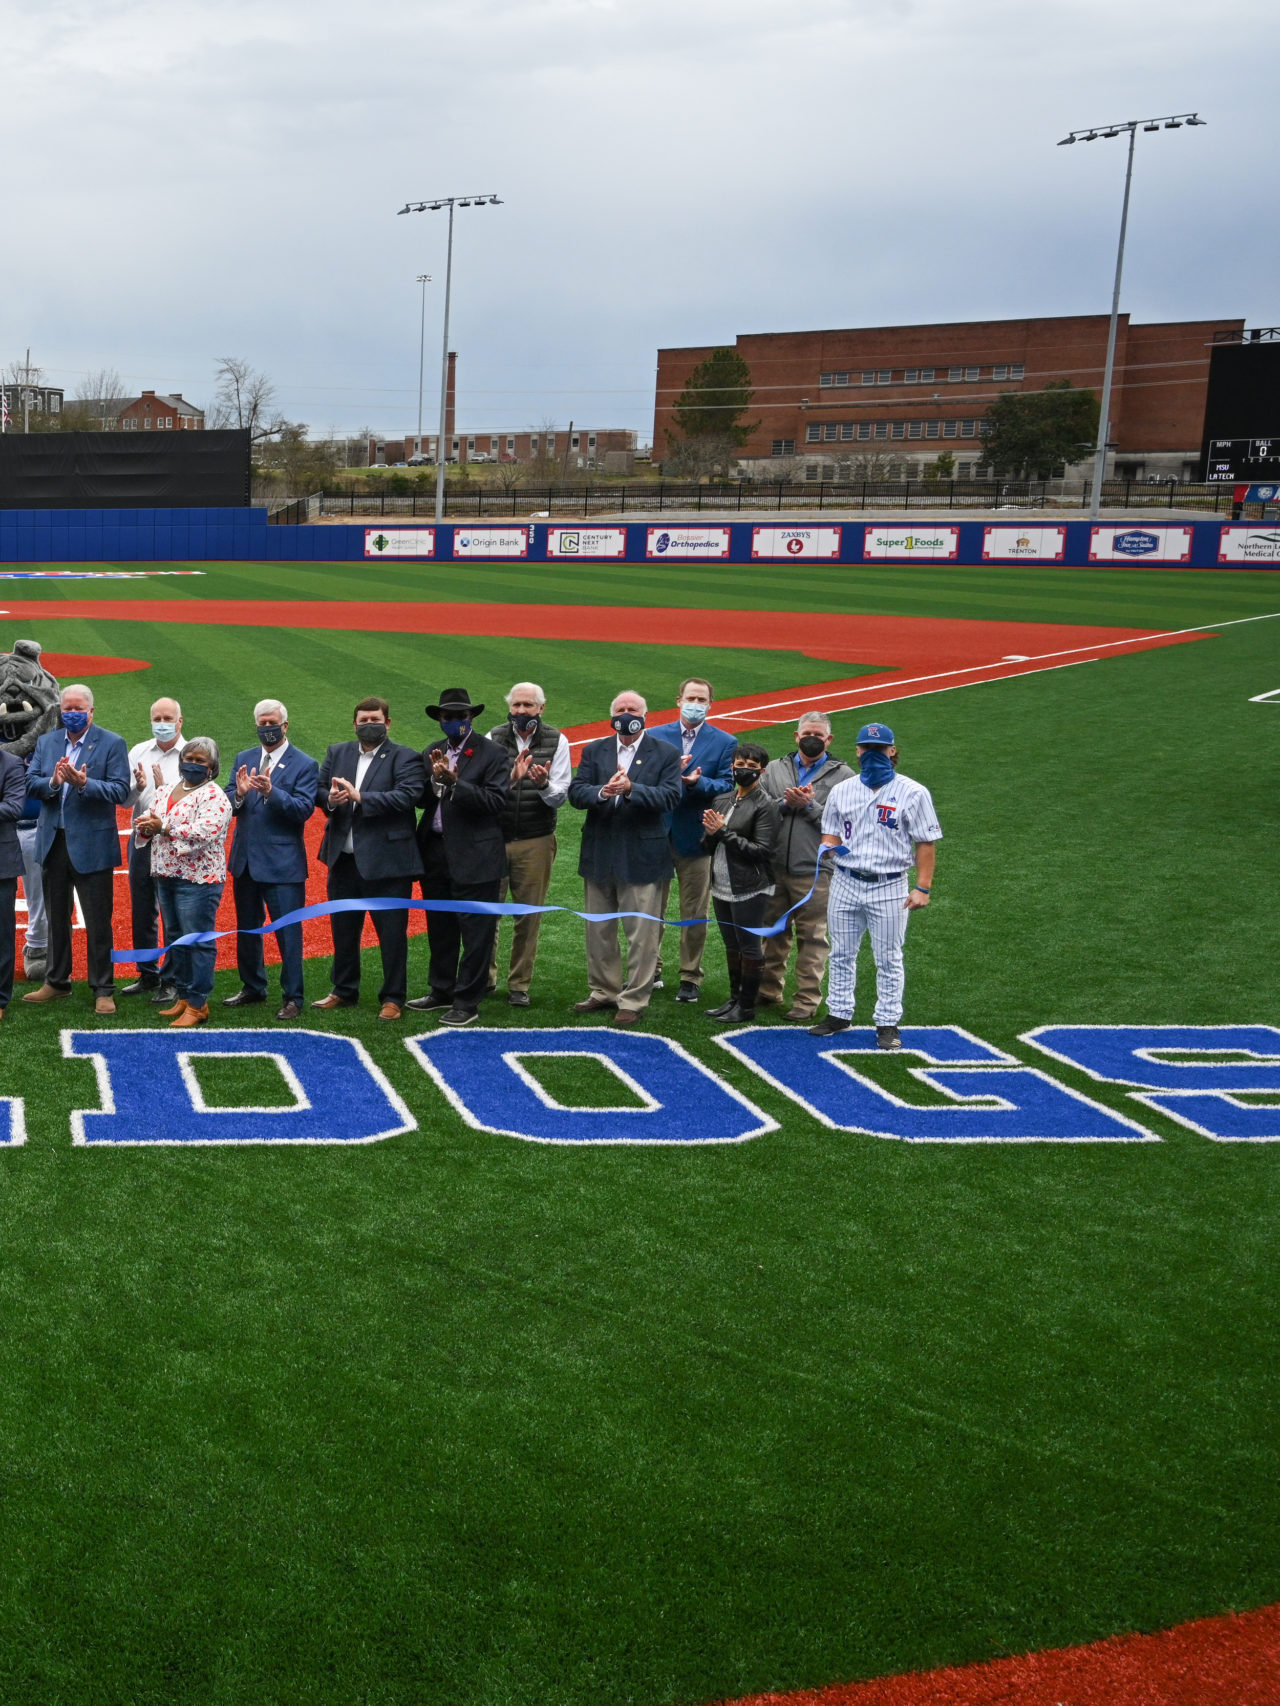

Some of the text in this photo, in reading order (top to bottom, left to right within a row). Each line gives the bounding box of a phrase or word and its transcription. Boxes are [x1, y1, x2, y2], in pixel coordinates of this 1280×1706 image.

[1260, 446, 1267, 456] 0
[472, 538, 519, 548] Origin Bank
[670, 540, 720, 550] Orthopedics
[876, 536, 944, 549] Super 1 Foods
[843, 820, 852, 840] 8
